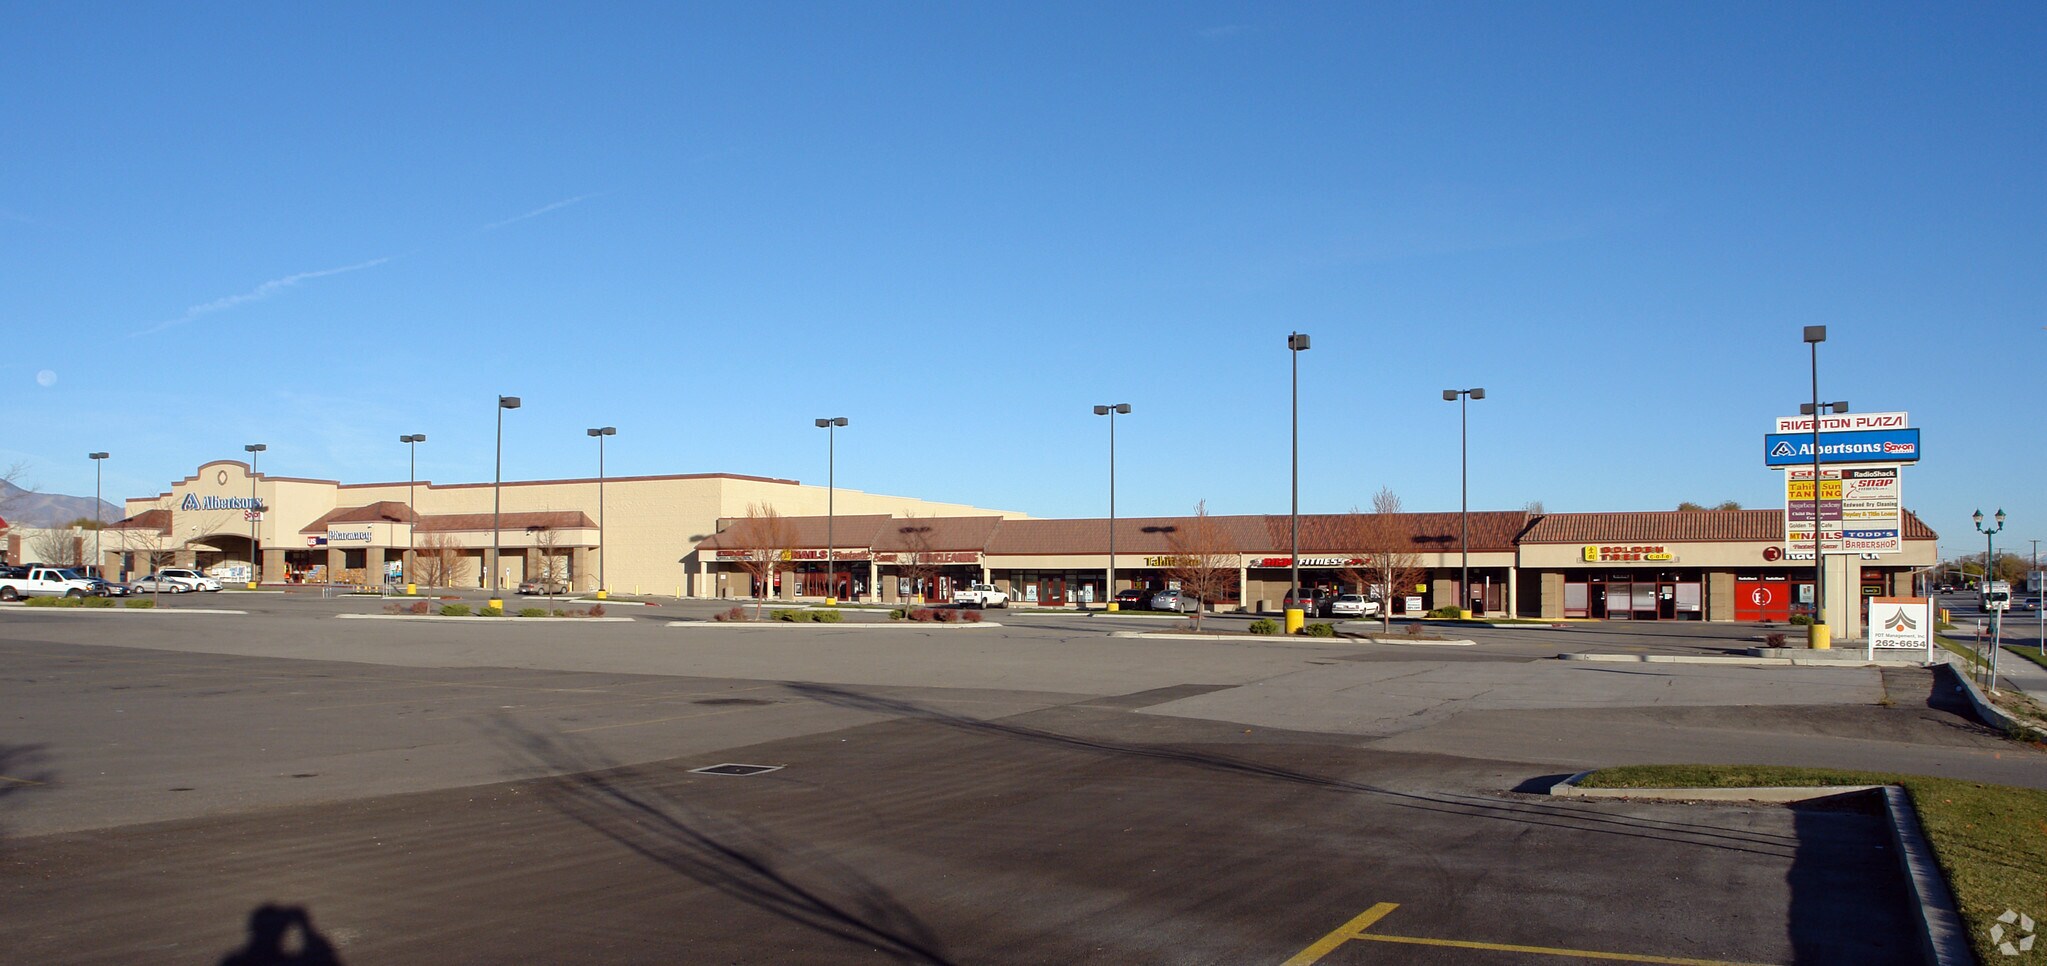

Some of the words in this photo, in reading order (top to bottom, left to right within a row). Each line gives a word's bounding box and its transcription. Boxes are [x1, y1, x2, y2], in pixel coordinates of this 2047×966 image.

[1856, 416, 1903, 428] PLAZA
[1853, 470, 1896, 478] RadioShack
[328, 530, 372, 543] Pharmacy
[791, 550, 829, 560] NAILS
[1875, 640, 1926, 648] 262-6654
